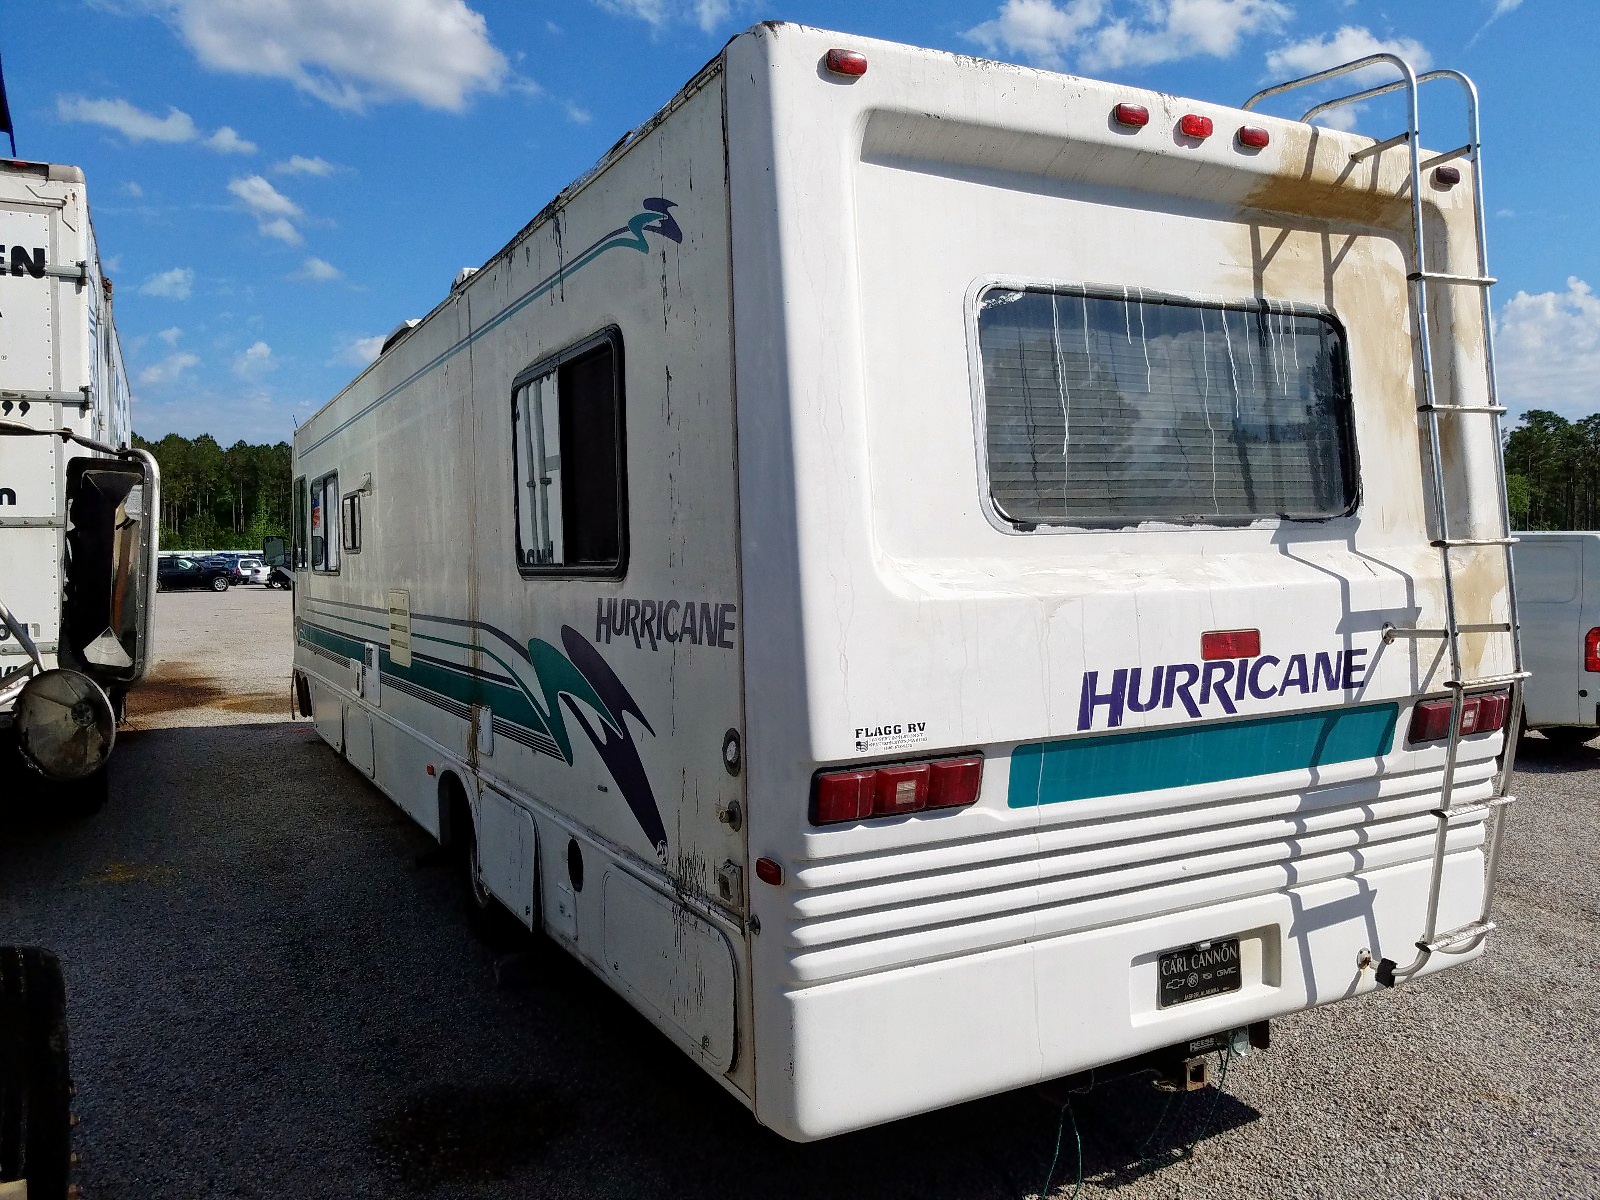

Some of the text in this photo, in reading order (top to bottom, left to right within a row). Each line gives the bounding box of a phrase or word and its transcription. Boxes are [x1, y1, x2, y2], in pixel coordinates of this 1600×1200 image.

[0, 245, 46, 279] N
[595, 597, 737, 652] HURRICANE
[1076, 648, 1368, 732] HURRICANE
[855, 724, 902, 739] FLAGG
[907, 721, 926, 733] RV
[1162, 945, 1238, 976] CARL CANNON
[1216, 966, 1237, 977] GMC
